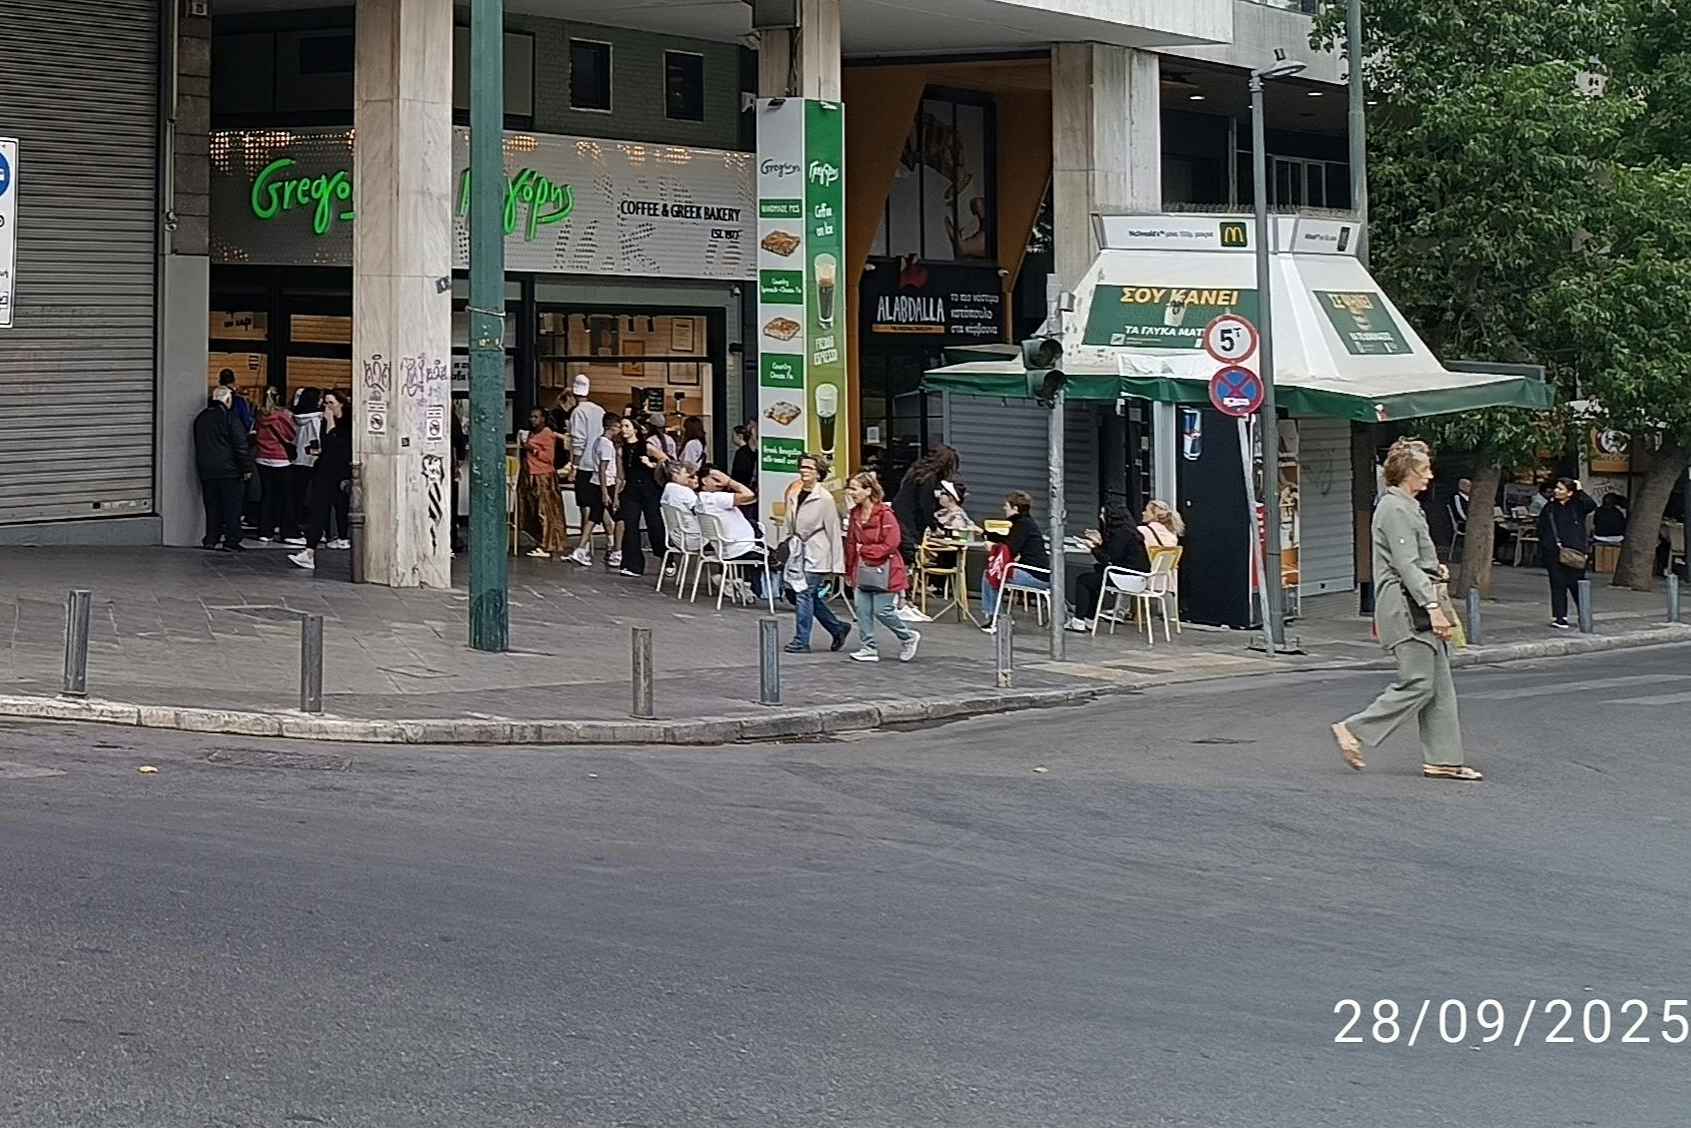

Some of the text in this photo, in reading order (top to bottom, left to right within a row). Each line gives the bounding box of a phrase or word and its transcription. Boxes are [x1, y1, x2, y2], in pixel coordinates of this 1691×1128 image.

[252, 158, 356, 234] Grego
[620, 200, 741, 222] COFFEE & GREEK BAKERY
[1120, 287, 1239, 305] ΣΟΥ ΚΑΝΕΙ
[876, 295, 946, 323] ALABDALLA
[1125, 325, 1142, 335] ΤΑ
[1178, 327, 1205, 337] ΜΑΤ
